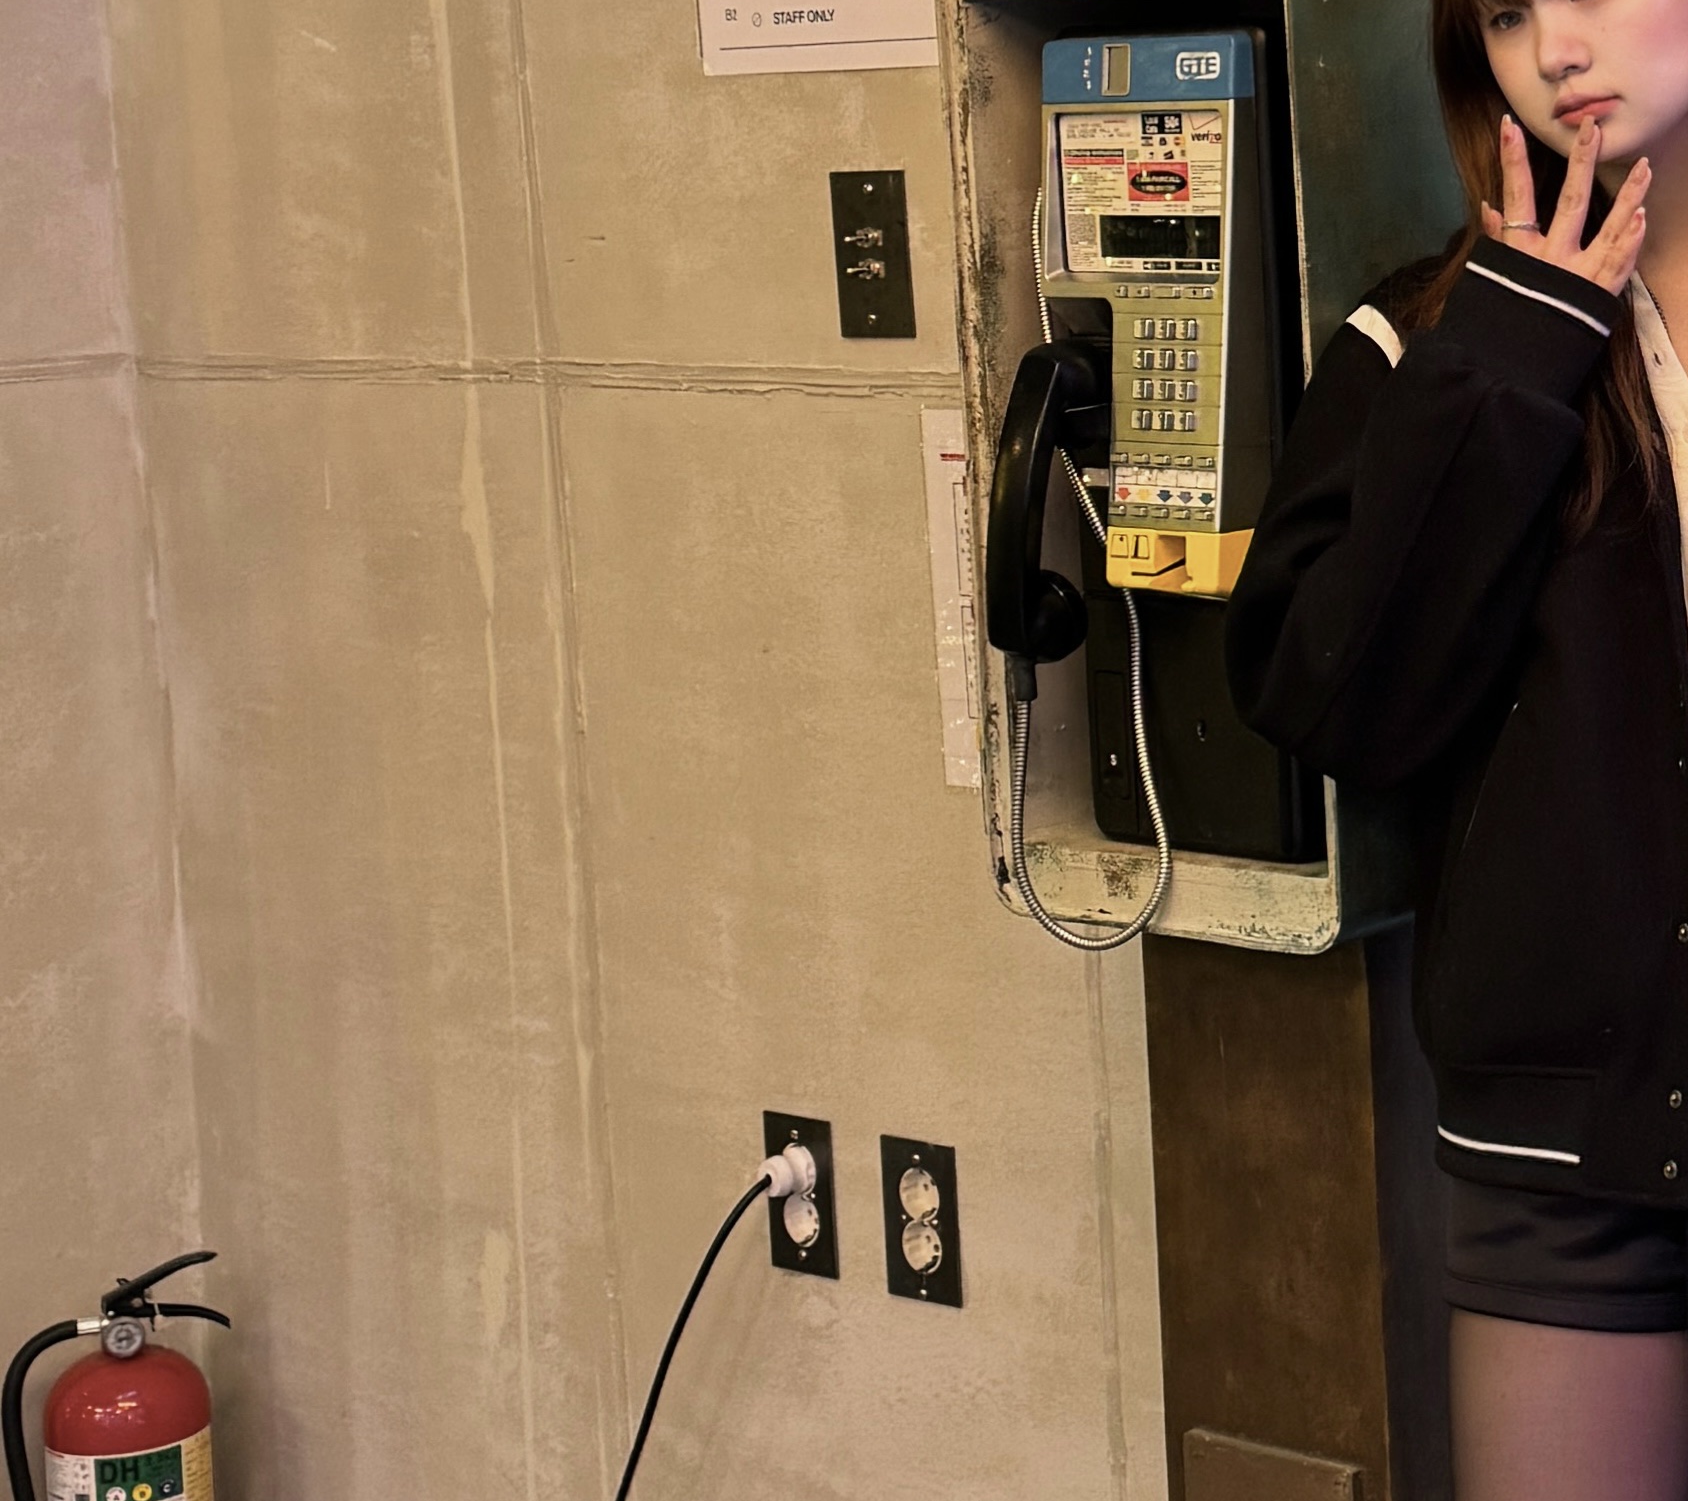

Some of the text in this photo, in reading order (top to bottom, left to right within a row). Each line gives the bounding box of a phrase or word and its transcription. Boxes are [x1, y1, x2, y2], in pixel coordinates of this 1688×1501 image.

[773, 11, 805, 25] STAFF
[807, 9, 835, 24] ONLY
[100, 1459, 139, 1484] DH
